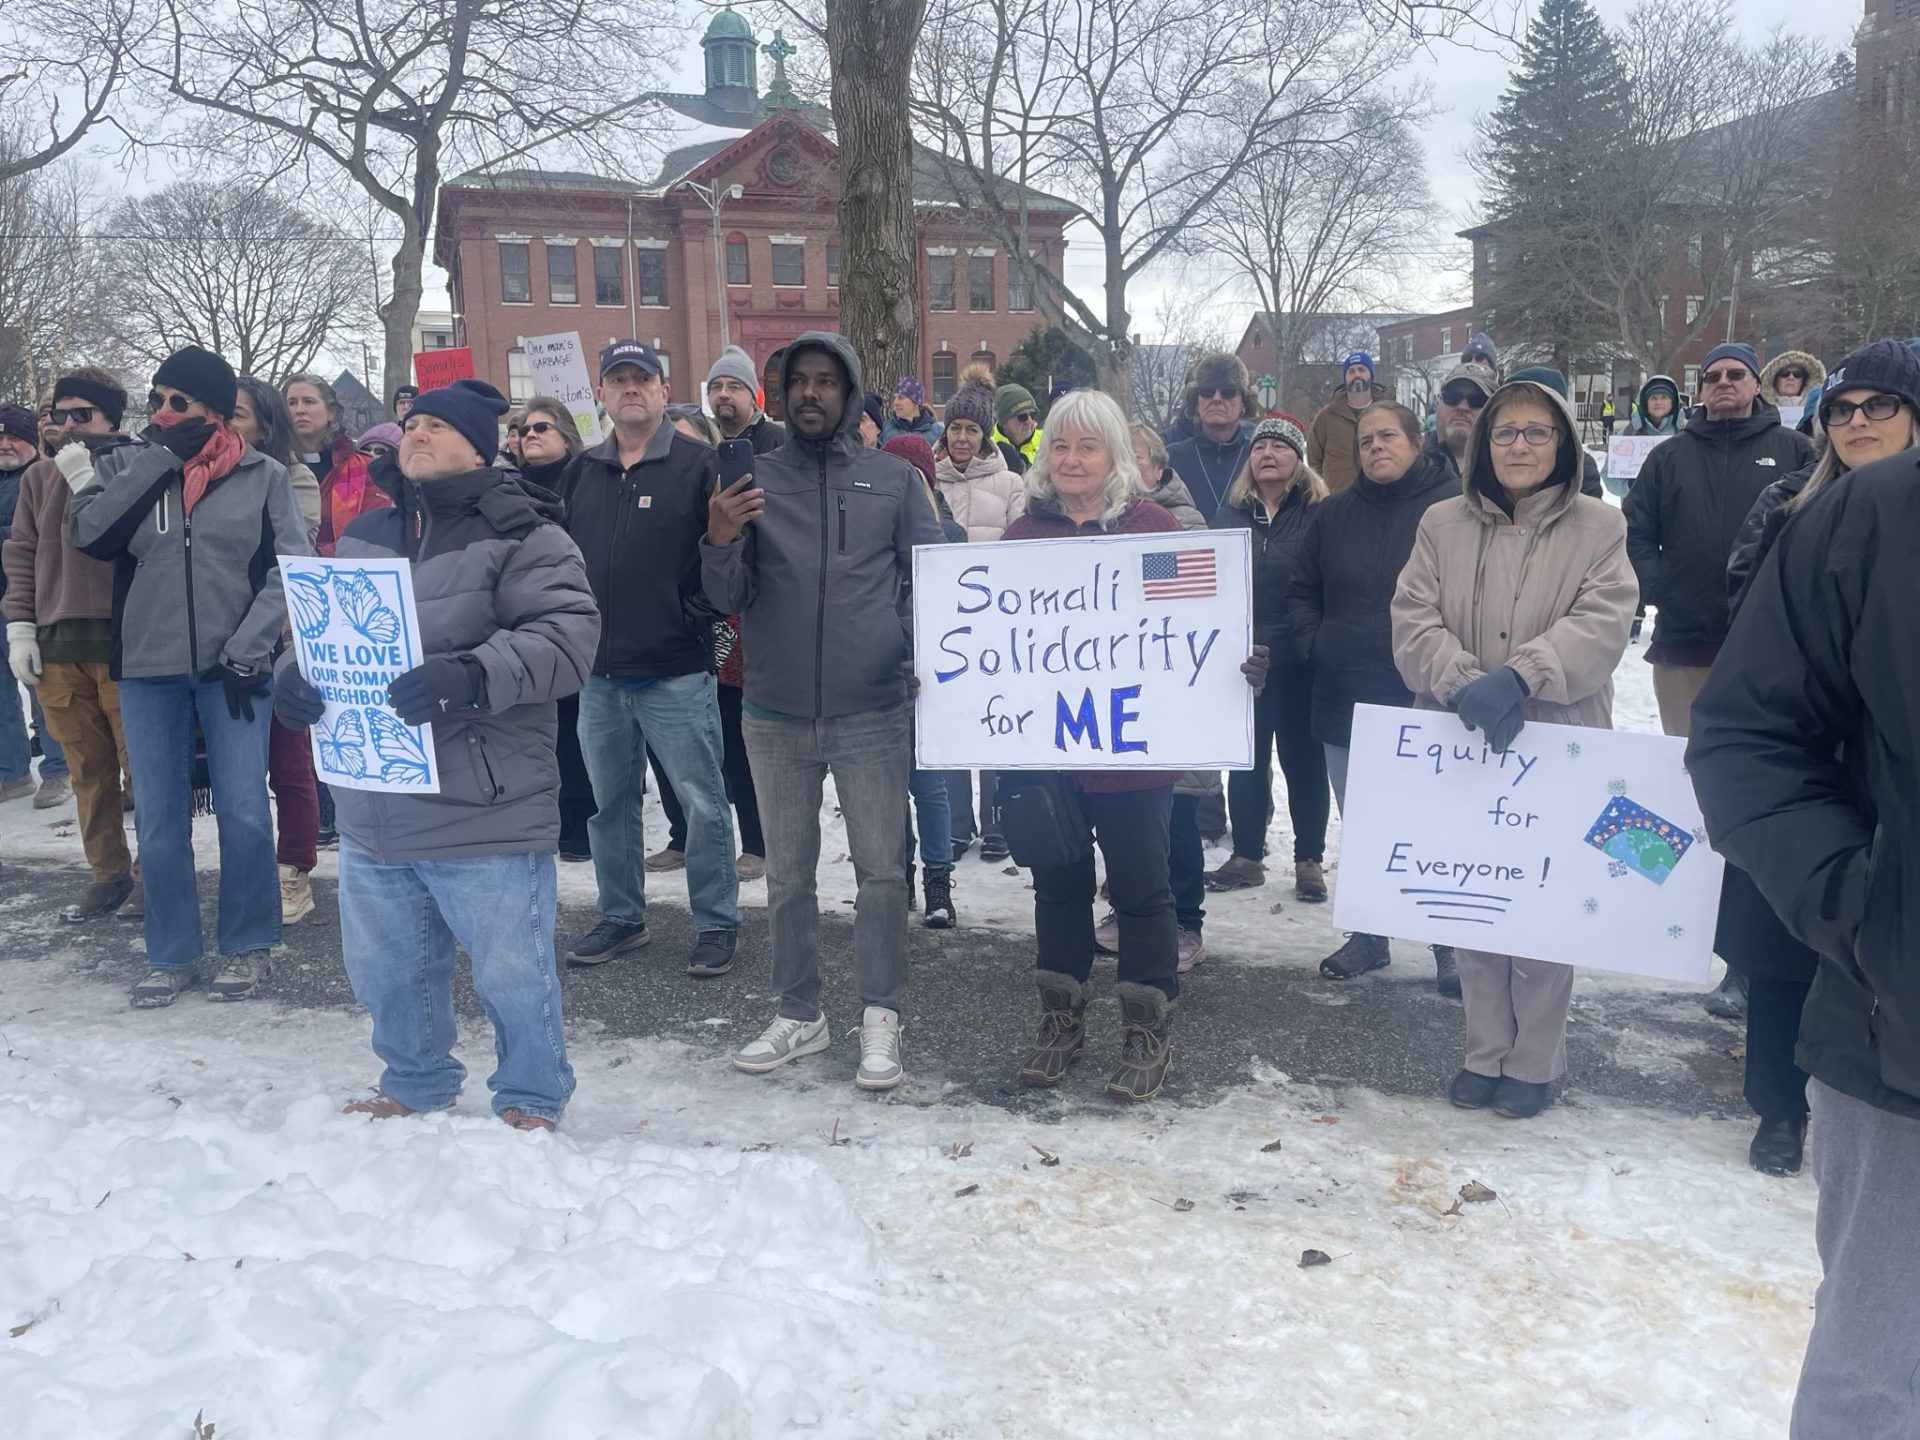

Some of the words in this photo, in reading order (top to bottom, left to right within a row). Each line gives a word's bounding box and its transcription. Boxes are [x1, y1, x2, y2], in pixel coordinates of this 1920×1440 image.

[527, 341, 544, 356] One
[547, 340, 574, 353] man's
[532, 353, 573, 371] GARBAGE
[534, 384, 592, 404] iston's
[958, 562, 1120, 615] Somali
[307, 641, 339, 665] WE
[345, 645, 404, 667] LOVE
[934, 616, 1221, 687] Solidarity
[311, 666, 339, 683] OUR
[342, 670, 404, 687] SOMA
[980, 694, 1034, 737] for
[1053, 683, 1149, 754] ME
[1396, 725, 1539, 787] Equity
[1487, 796, 1540, 829] for
